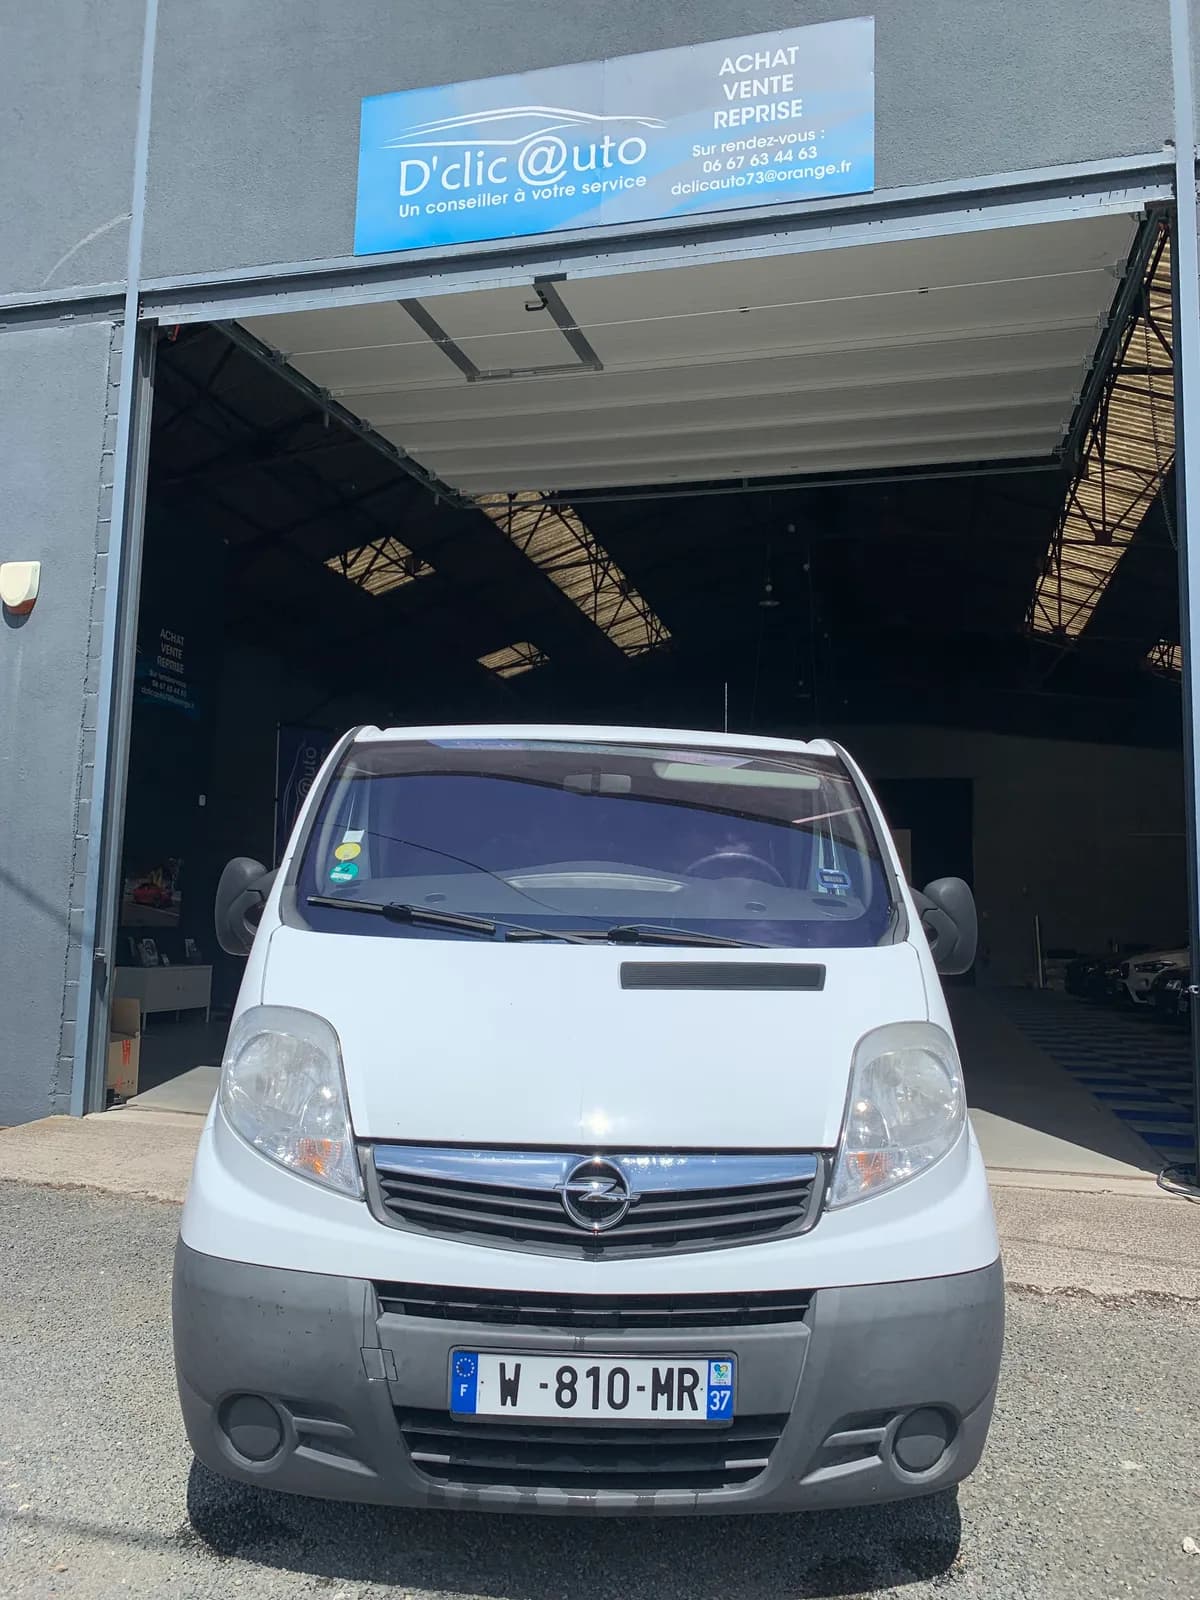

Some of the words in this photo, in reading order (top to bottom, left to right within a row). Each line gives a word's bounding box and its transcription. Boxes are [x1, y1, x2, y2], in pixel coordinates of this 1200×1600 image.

[719, 46, 799, 76] ACHAT
[723, 74, 793, 100] VENTE
[714, 98, 802, 129] REPRISE
[692, 144, 717, 157] Sur
[721, 130, 816, 153] rendez-vous
[400, 151, 507, 196] D'clic
[518, 136, 646, 185] @uto
[703, 160, 721, 173] 06
[726, 156, 744, 170] 67
[750, 153, 769, 167] 63
[774, 149, 793, 163] 44
[798, 146, 817, 160] 63
[671, 160, 852, 195] dclicauto73@orange.fr
[400, 204, 419, 217] Un
[426, 193, 508, 214] conseiller
[514, 188, 525, 202] à
[532, 184, 575, 200] votre
[582, 175, 646, 194] service
[160, 628, 184, 646] ACHAT
[460, 1384, 468, 1397] F
[710, 1390, 731, 1411] 37
